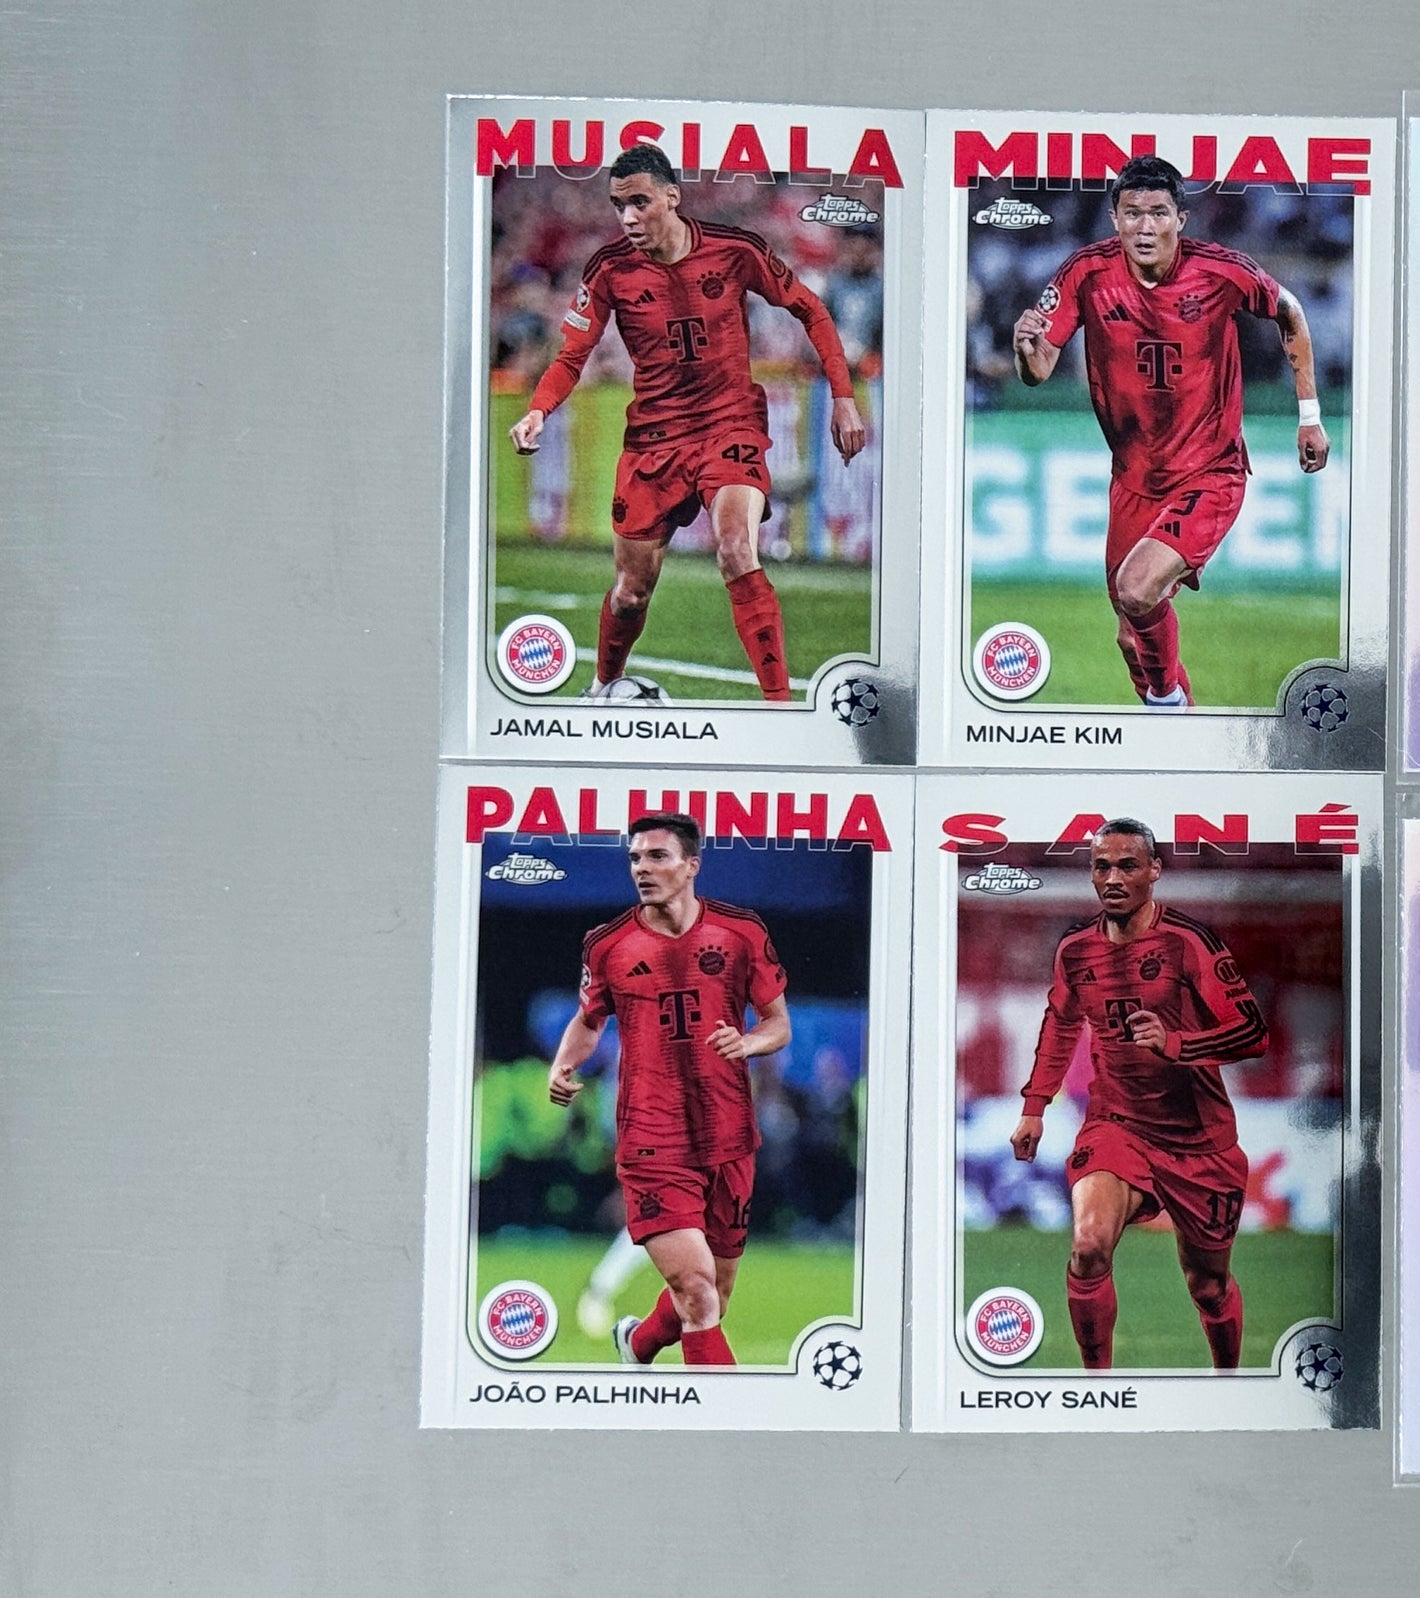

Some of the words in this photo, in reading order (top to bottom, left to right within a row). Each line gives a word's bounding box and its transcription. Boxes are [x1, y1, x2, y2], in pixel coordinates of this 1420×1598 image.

[953, 131, 1371, 196] MINJAE
[802, 207, 879, 222] Chrome
[975, 210, 1051, 225] Chrome
[721, 444, 762, 465] 42
[511, 635, 524, 650] FC
[525, 626, 562, 651] BAYERN
[986, 641, 1000, 656] FC
[1000, 633, 1037, 658] BAYERN
[489, 718, 583, 738] JAMAL
[592, 719, 719, 741] MUSIALA
[966, 725, 1066, 744] MINJAE
[1075, 726, 1122, 745] KIM
[938, 803, 1359, 855] SANÉ
[489, 866, 566, 881] Chrome
[965, 875, 1040, 890] Chrome
[494, 1301, 506, 1316] FC
[505, 1292, 541, 1317] BAYERN
[980, 1307, 993, 1322] FC
[993, 1297, 1029, 1322] BAYERN
[469, 1381, 546, 1404] JOÃO
[555, 1385, 701, 1405] PALHINHA
[960, 1391, 1052, 1409] LEROY
[1061, 1387, 1138, 1409] SANÉ
